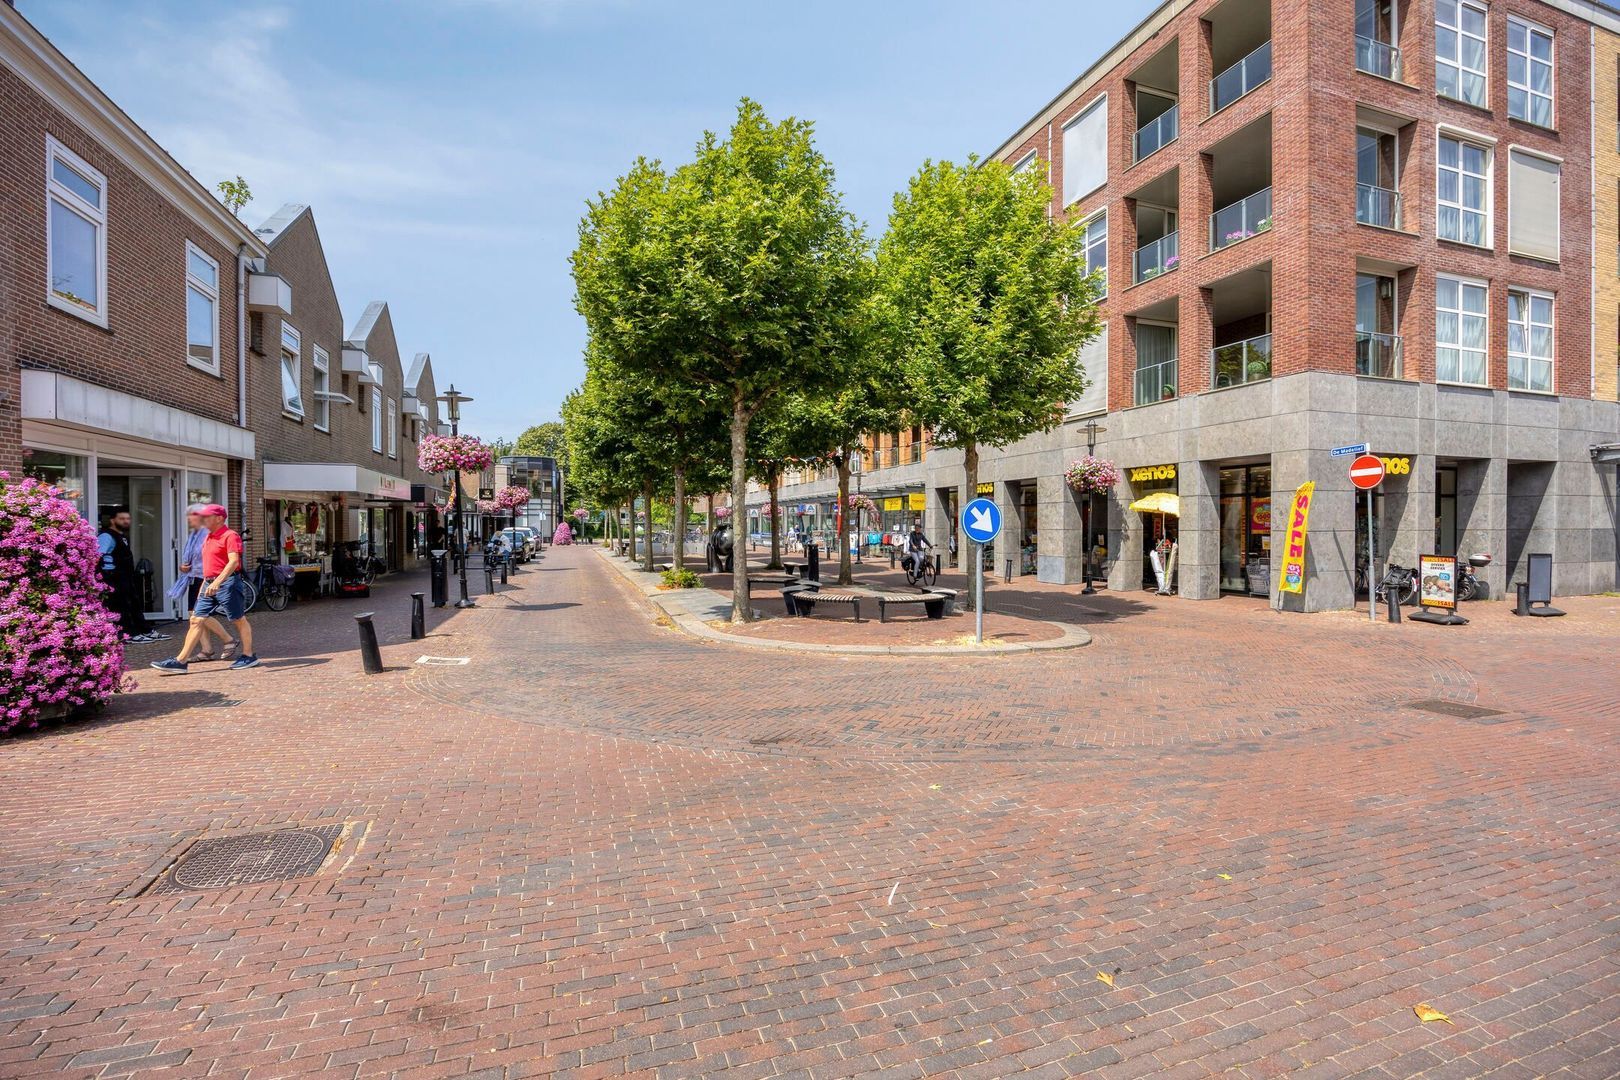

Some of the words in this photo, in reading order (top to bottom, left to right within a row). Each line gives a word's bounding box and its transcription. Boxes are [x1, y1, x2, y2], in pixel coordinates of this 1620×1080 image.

[1380, 457, 1410, 475] nos
[977, 483, 994, 495] enos
[1290, 495, 1309, 558] SALE
